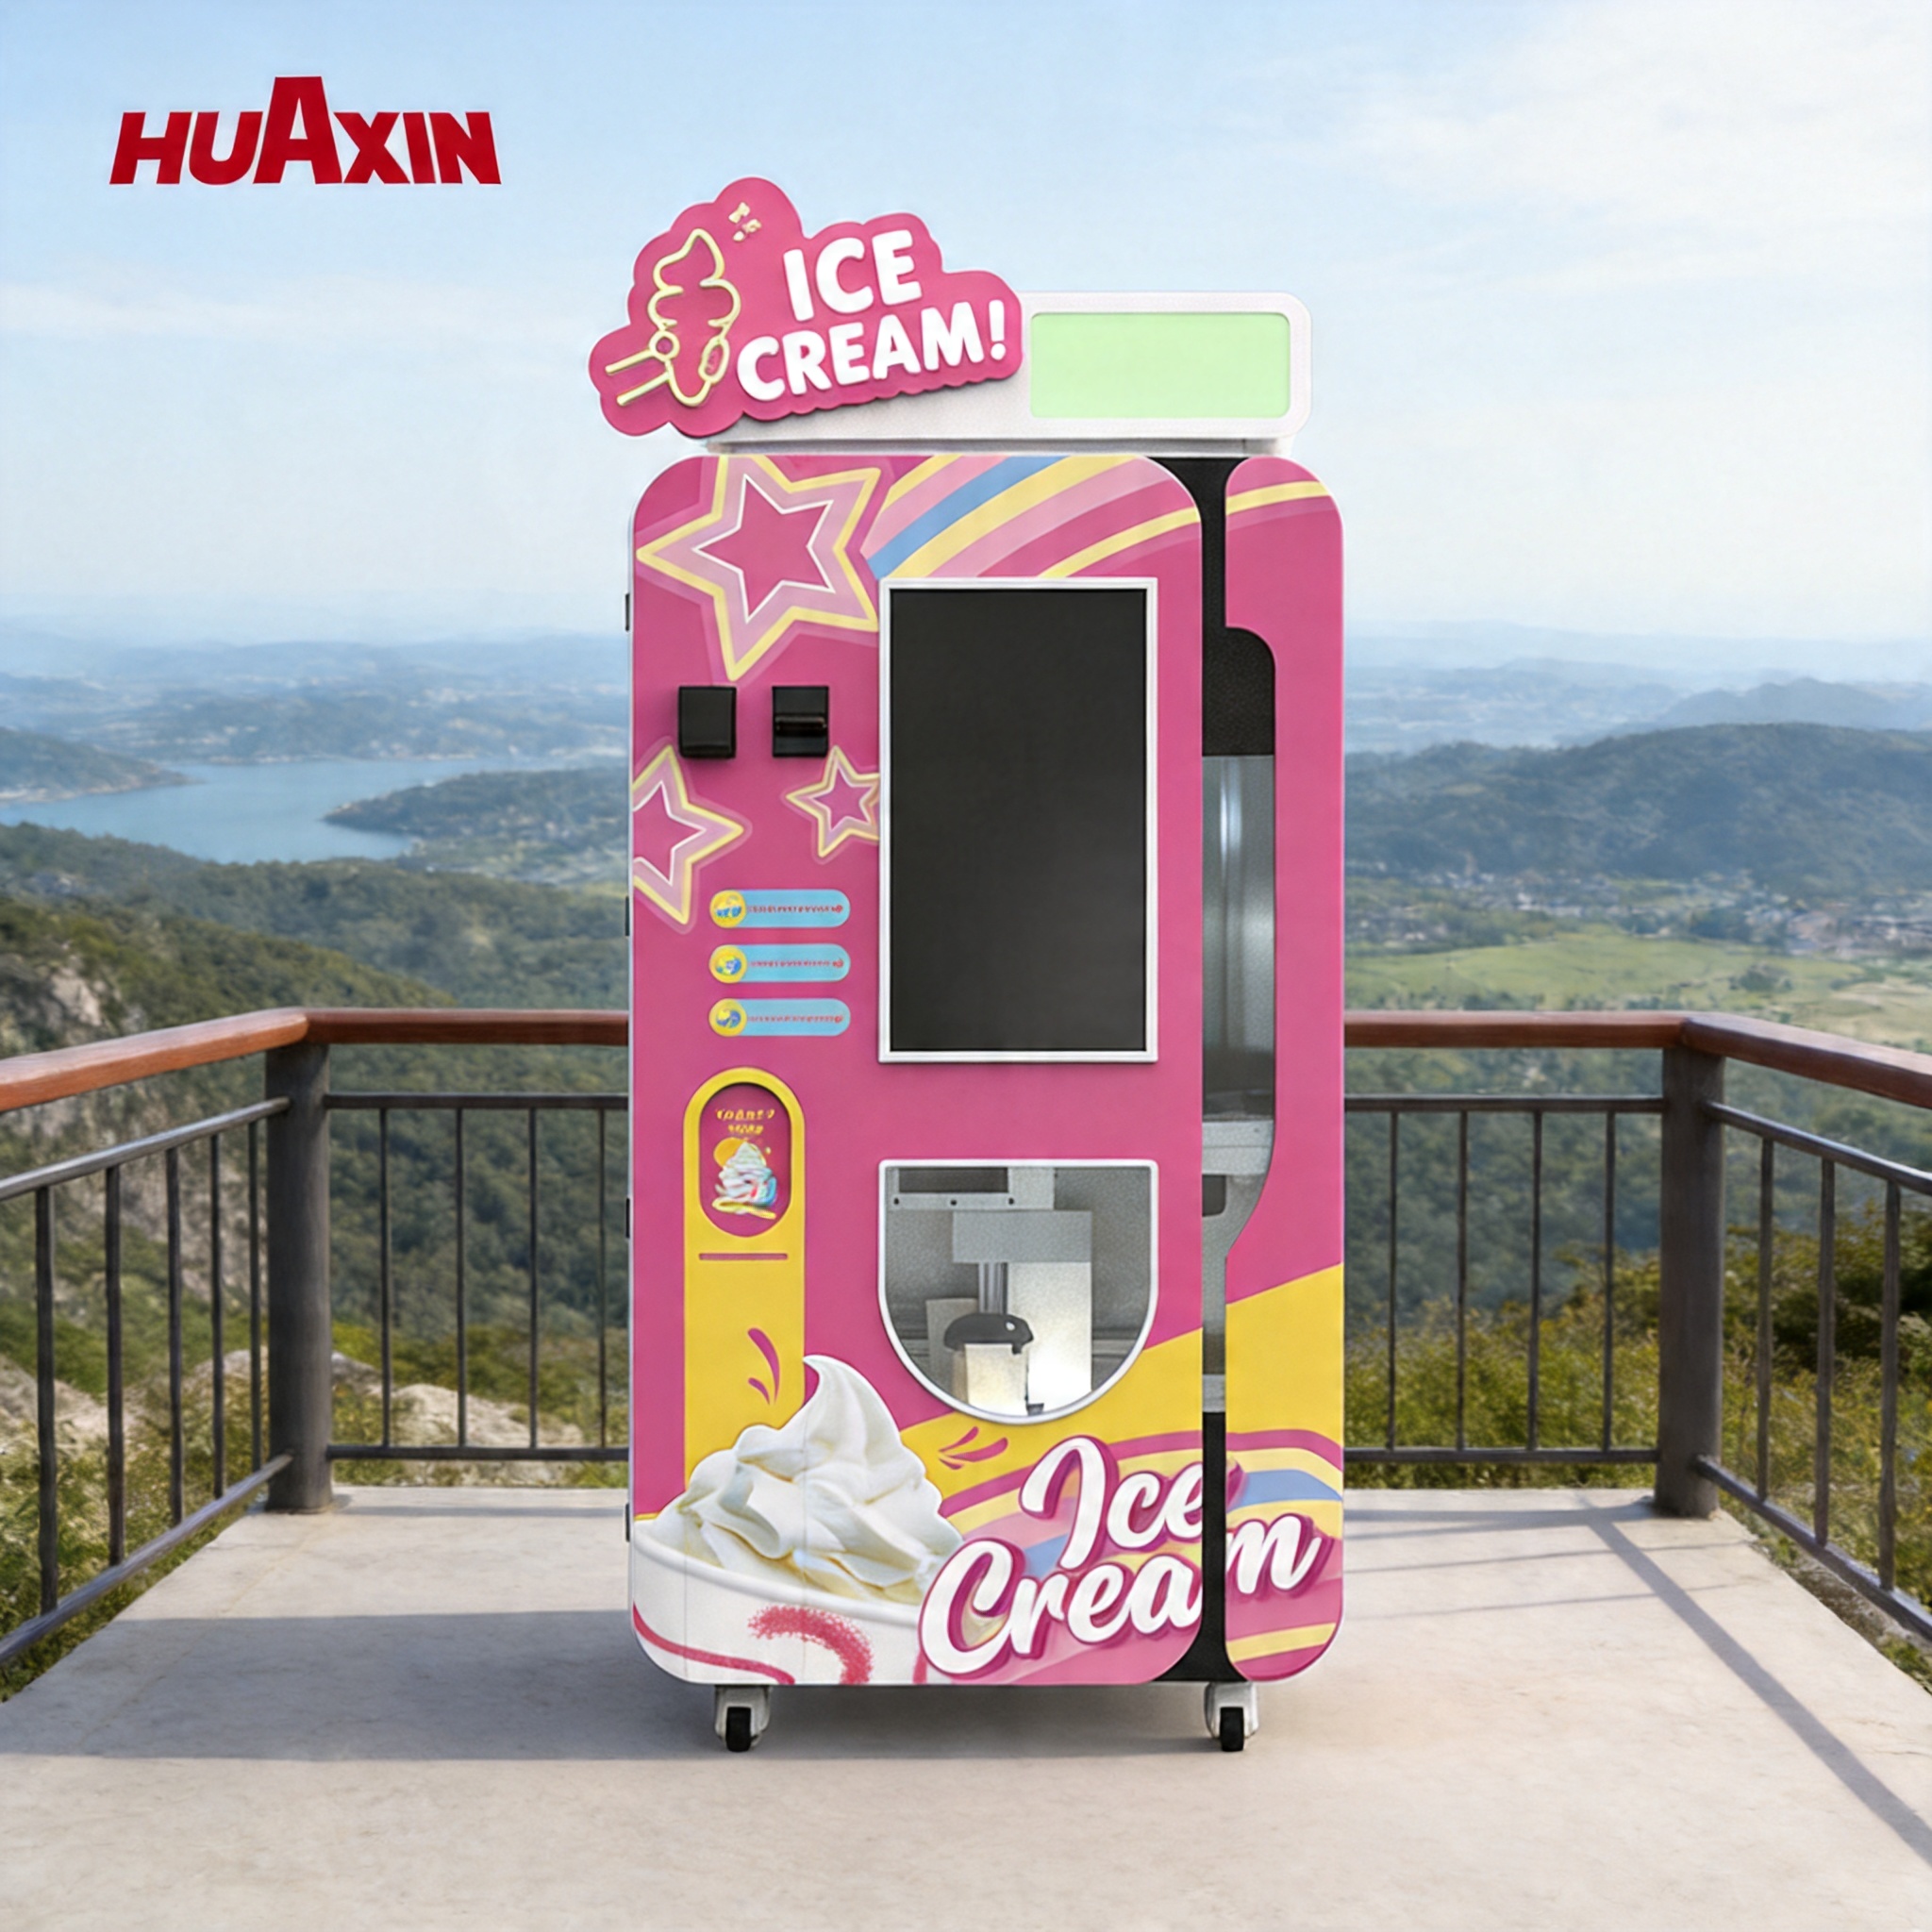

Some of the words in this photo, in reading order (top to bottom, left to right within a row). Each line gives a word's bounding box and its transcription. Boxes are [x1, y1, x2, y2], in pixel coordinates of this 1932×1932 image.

[783, 229, 922, 322] ICE
[737, 300, 1006, 402] CREAM!
[1020, 1436, 1204, 1570] Ice
[921, 1514, 1322, 1674] Cream
